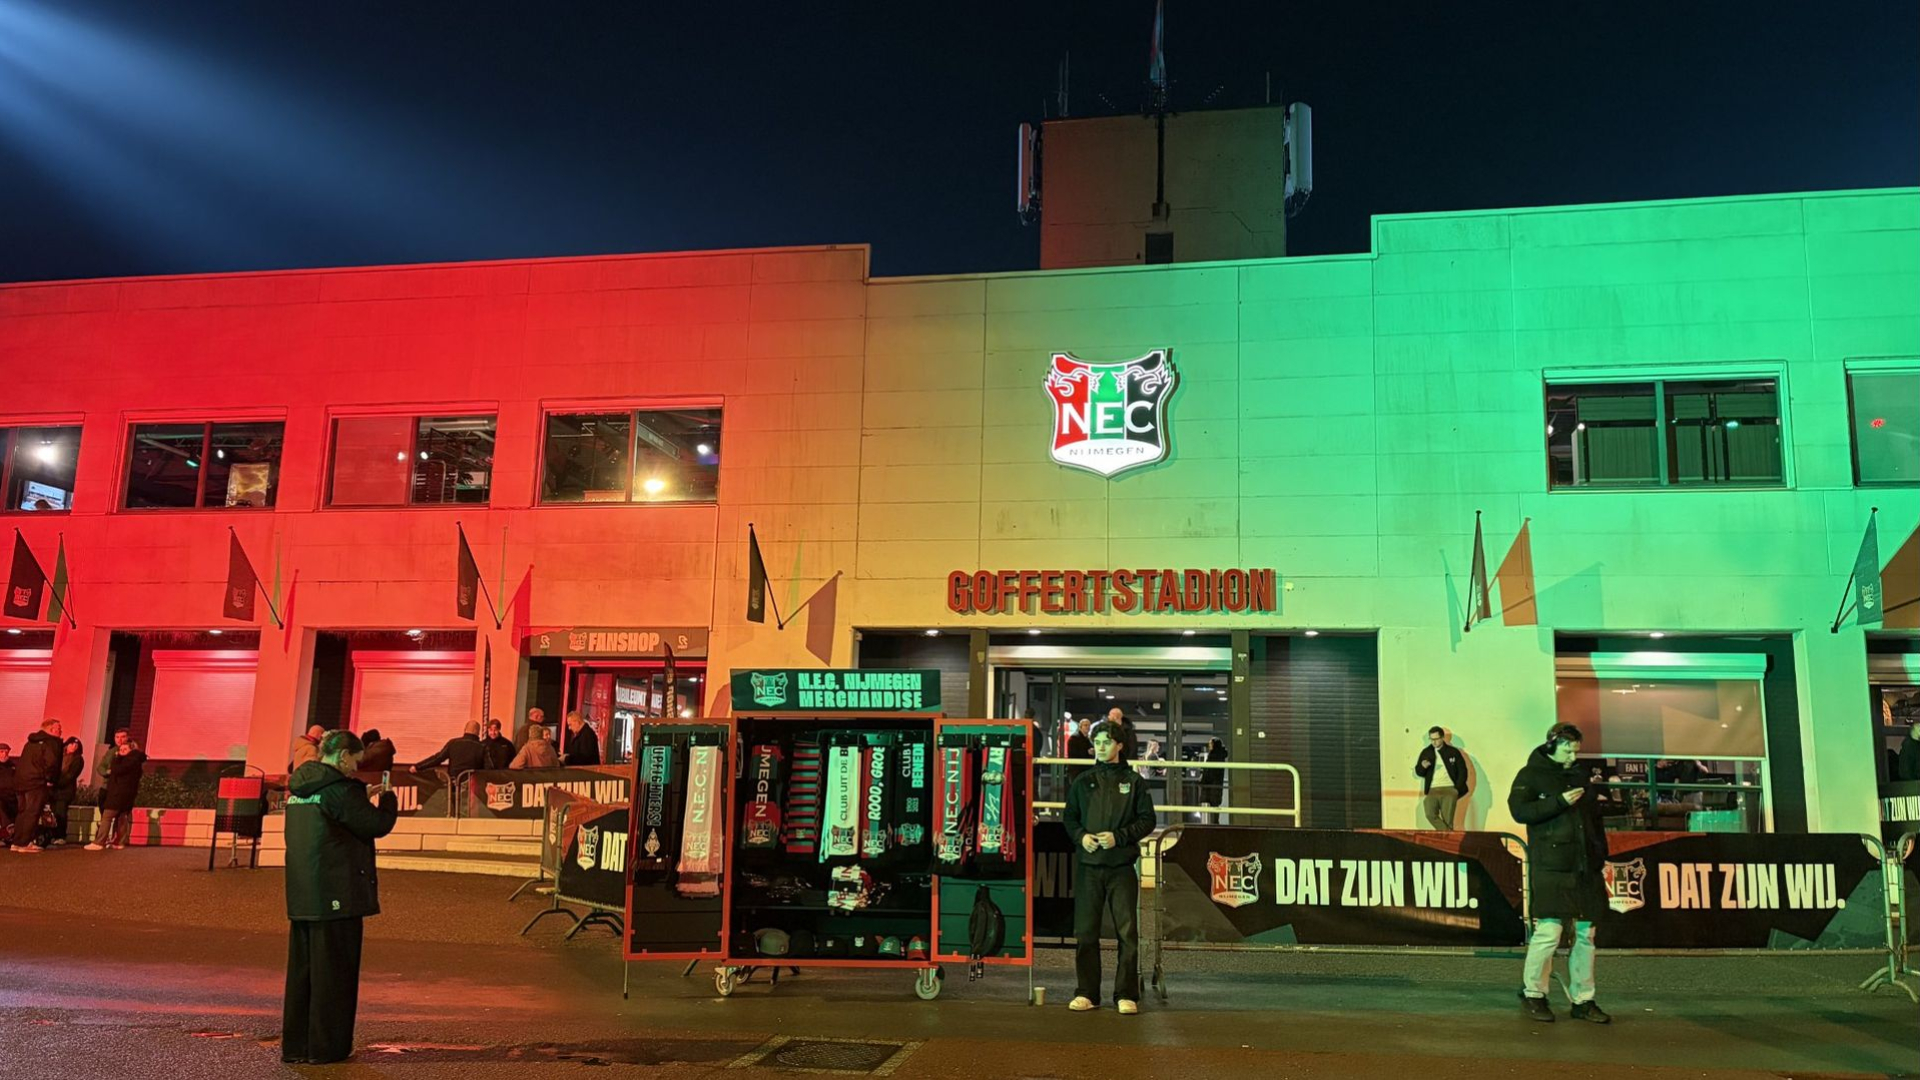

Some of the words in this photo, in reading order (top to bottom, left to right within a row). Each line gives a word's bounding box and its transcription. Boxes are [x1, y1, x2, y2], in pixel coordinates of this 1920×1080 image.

[1061, 401, 1155, 435] NEC
[947, 568, 1277, 613] GOFFERTSTADION
[588, 632, 660, 652] FANSHOP
[757, 687, 783, 696] NEC
[798, 673, 840, 690] N.E.C.
[844, 673, 922, 690] NIJMEGEN
[799, 691, 922, 708] MERCHANDISE
[871, 747, 885, 778] GROE
[902, 749, 911, 778] CLUB
[912, 743, 925, 788] BENED
[647, 746, 665, 827] UPFIGHTERS!
[755, 745, 772, 817] JMEGEN
[840, 777, 848, 794] UIT
[491, 794, 512, 803] NEC
[840, 795, 849, 821] CLUB
[601, 831, 628, 873] DAT
[1215, 875, 1254, 890] NEC
[1275, 858, 1333, 905] DAT
[1340, 860, 1404, 907] ZIJN
[1411, 861, 1479, 908] WIJ.
[1659, 863, 1713, 909] DAT
[1719, 864, 1779, 909] ZIJN
[1784, 864, 1846, 909] WIJ.
